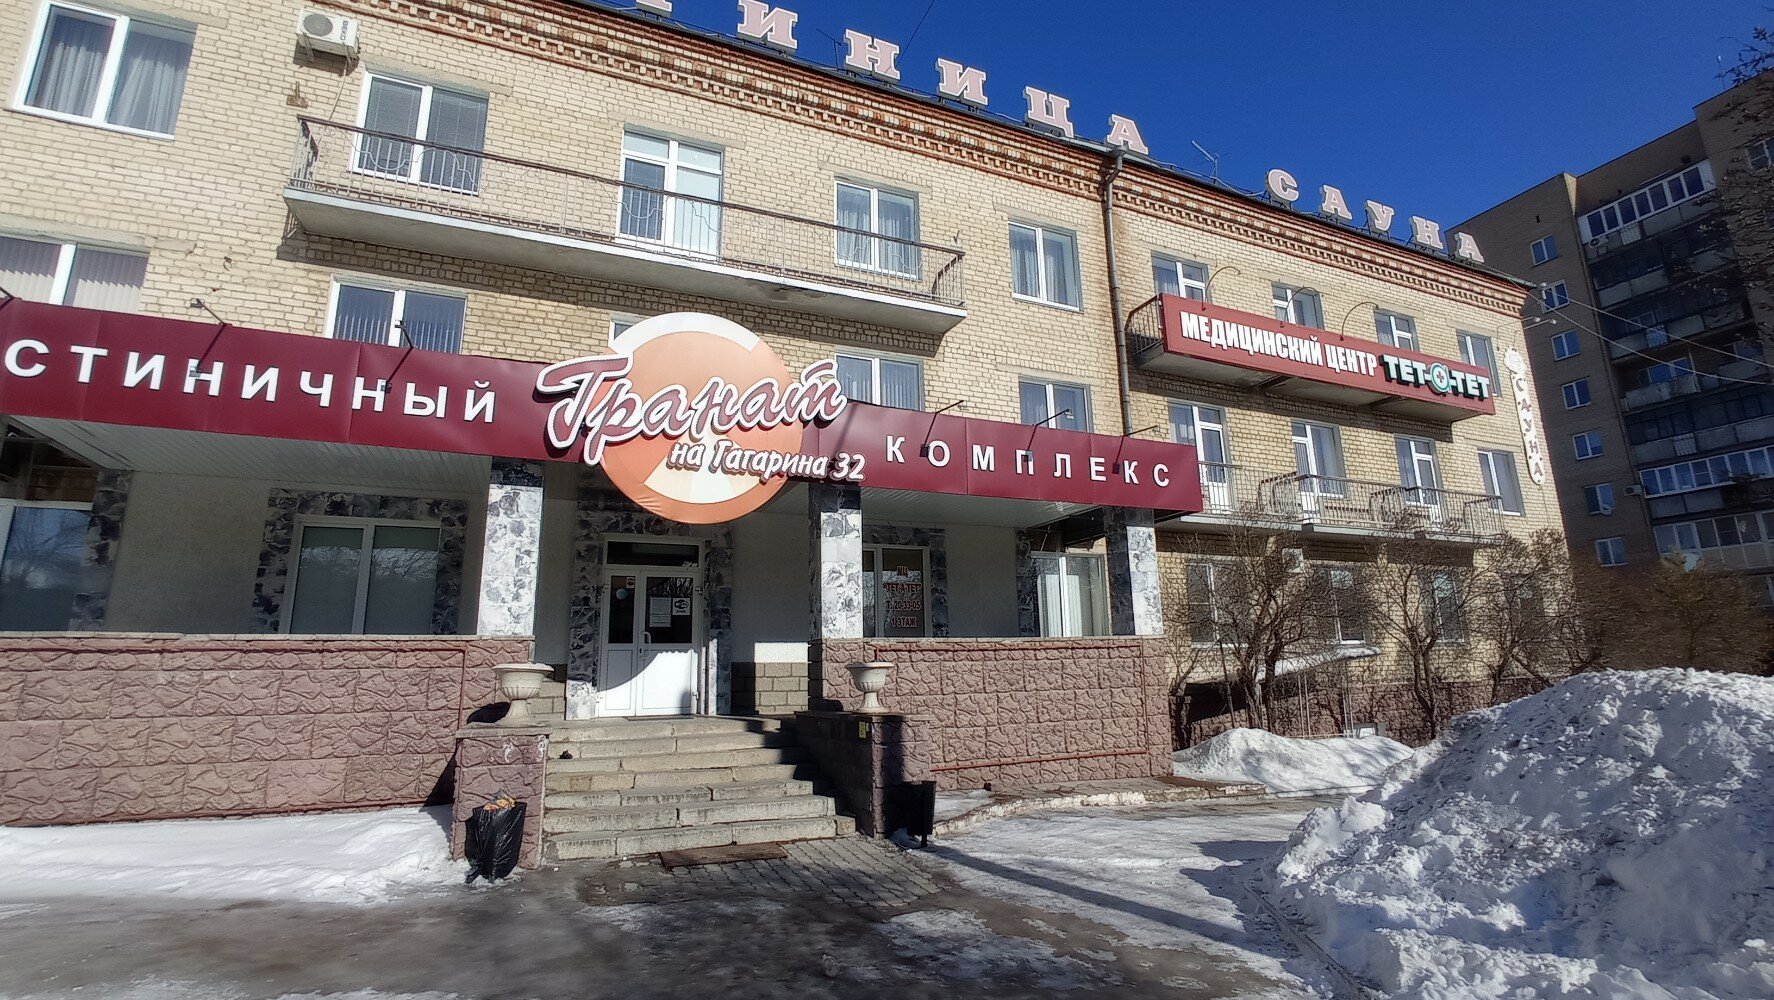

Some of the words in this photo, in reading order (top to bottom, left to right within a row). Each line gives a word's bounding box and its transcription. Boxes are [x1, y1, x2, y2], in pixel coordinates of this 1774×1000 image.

[636, 0, 1149, 155] ИНИЦА
[1267, 168, 1485, 263] САУНА
[4, 338, 497, 424] СТИНИЧНЫЙ
[1179, 310, 1323, 367] МЕДИЦИНСКИЙ
[1325, 343, 1378, 377] ЦЕНТР
[536, 350, 848, 466] Гранат
[1515, 377, 1544, 477] САУНА
[670, 441, 704, 468] на
[714, 440, 830, 484] Гагарина
[831, 452, 867, 481] 32
[886, 435, 1171, 488] КОМПЛЕКС
